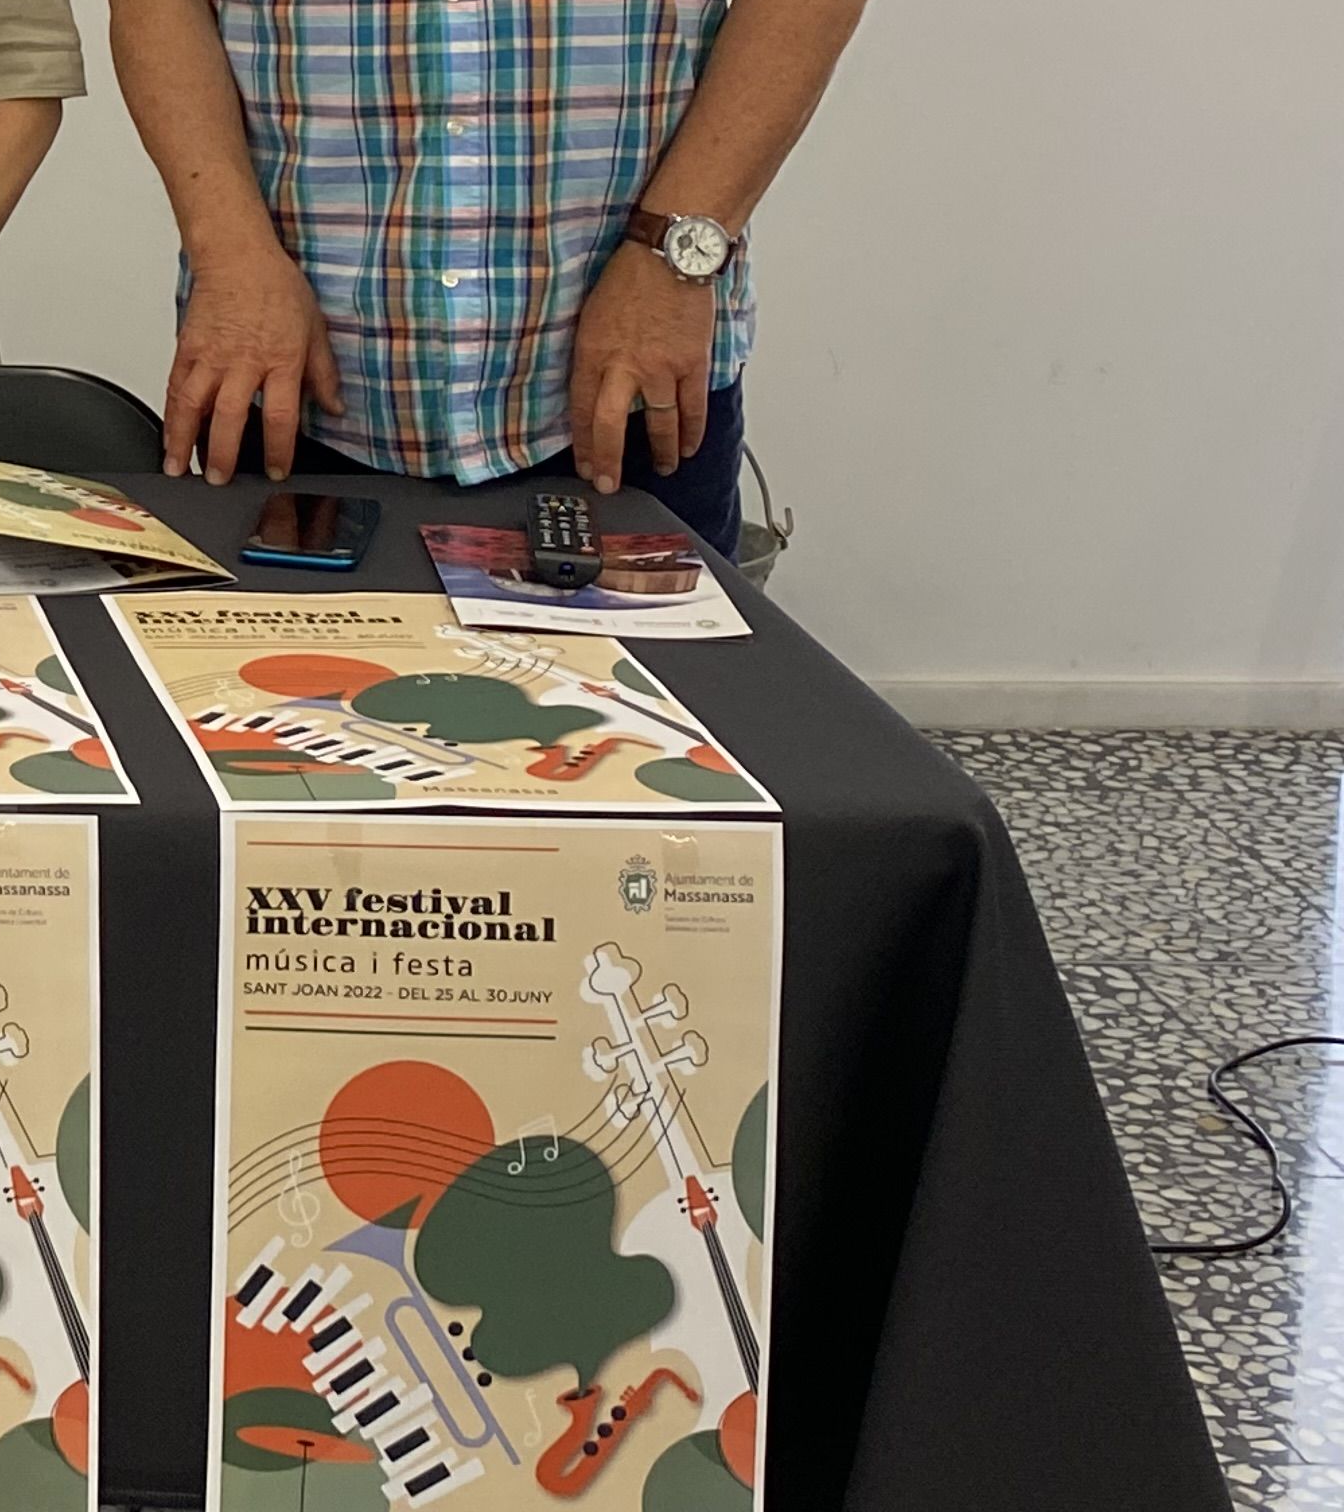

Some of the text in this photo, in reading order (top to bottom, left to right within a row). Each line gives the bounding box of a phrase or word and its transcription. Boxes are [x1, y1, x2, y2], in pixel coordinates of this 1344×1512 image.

[54, 868, 70, 879] de
[664, 873, 754, 887] Ajuntament de
[246, 887, 513, 917] XXV festival
[664, 888, 755, 903] Massanassa
[246, 909, 558, 944] internacional
[246, 949, 474, 977] música i festa
[243, 982, 287, 996] SANT
[291, 983, 339, 997] JOAN
[343, 985, 382, 999] 2022
[398, 987, 430, 1001] DEL
[434, 988, 453, 1001] 25
[457, 988, 481, 1003] AL
